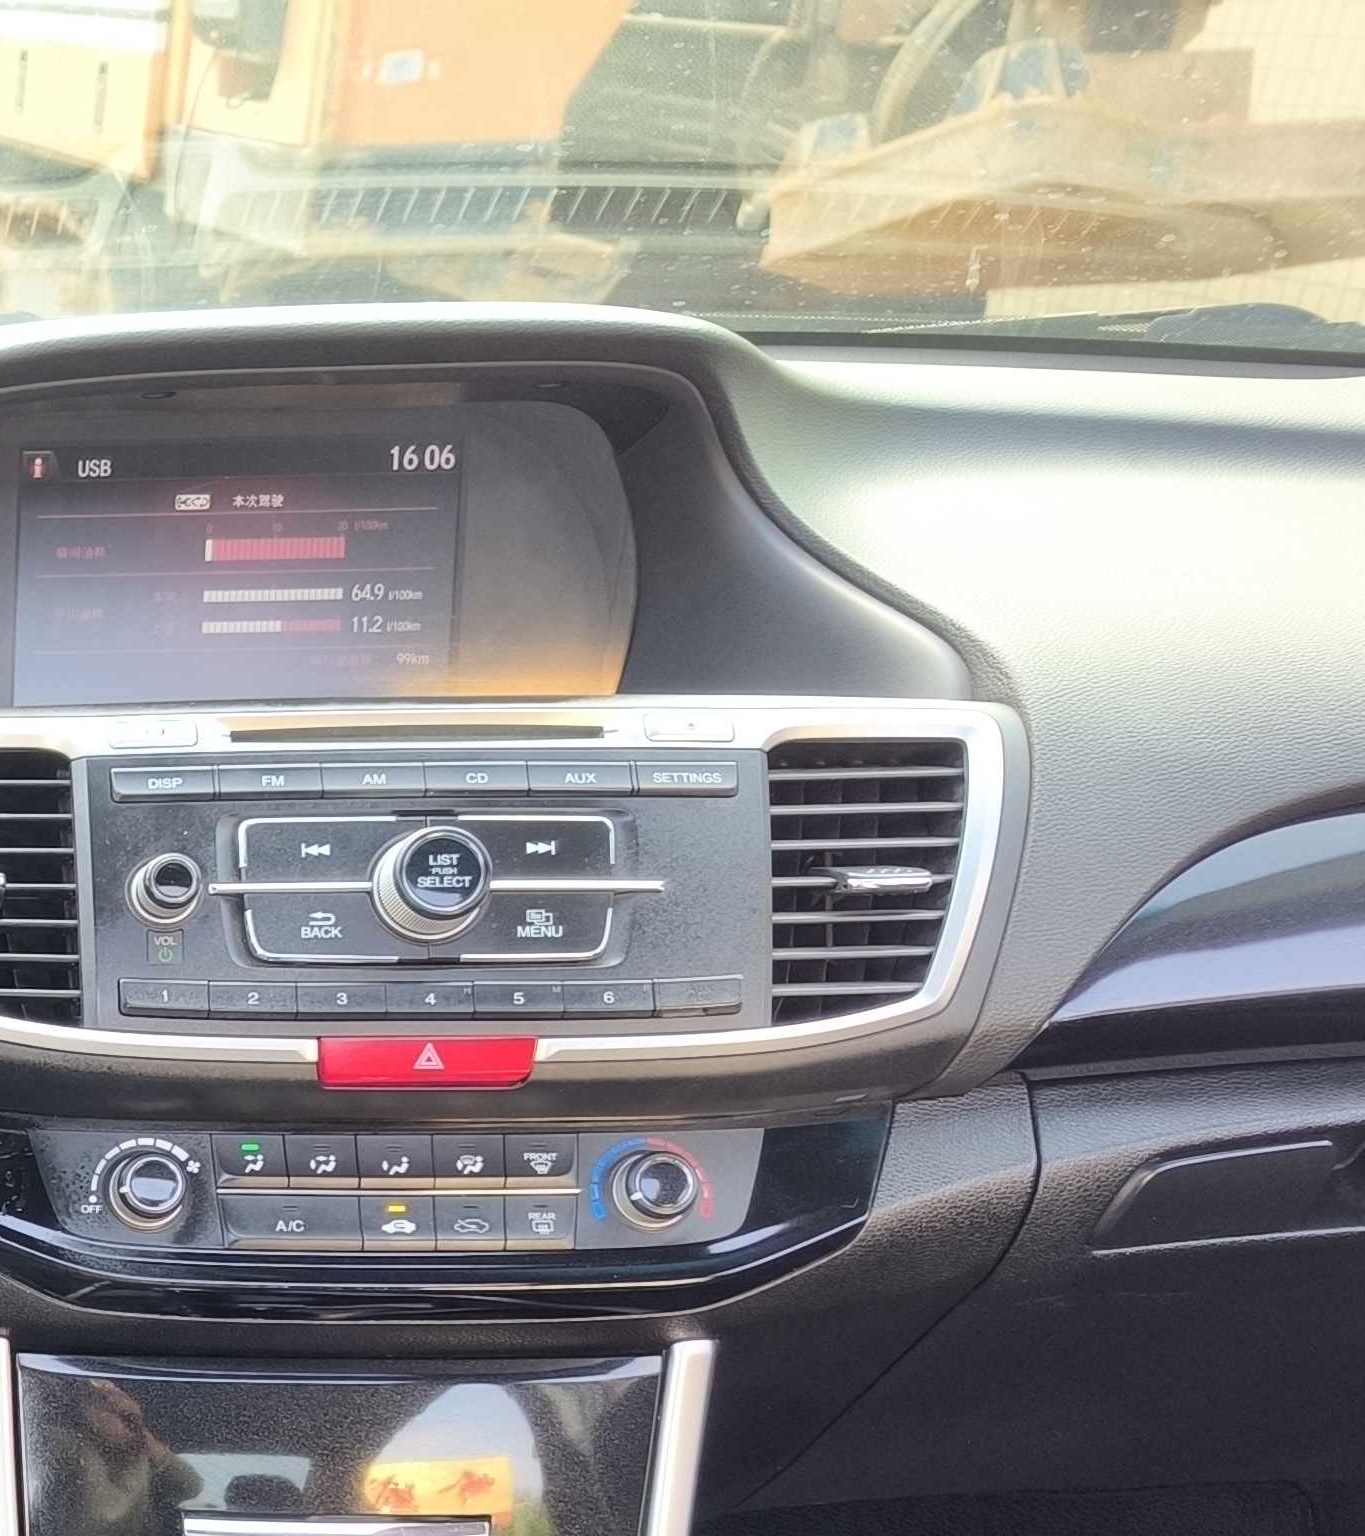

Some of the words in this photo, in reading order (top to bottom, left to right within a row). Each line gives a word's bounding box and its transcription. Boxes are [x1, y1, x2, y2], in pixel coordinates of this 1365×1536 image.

[77, 459, 112, 477] USB
[351, 583, 385, 601] 64.9
[351, 615, 383, 633] 11.2
[148, 777, 183, 789] DISP
[261, 775, 285, 787] FM
[362, 773, 387, 785] AM
[465, 772, 489, 784] CD
[564, 772, 597, 784] AUX
[652, 772, 723, 784] SETTINGS
[428, 854, 460, 866] LIST
[417, 876, 473, 888] SELECT
[300, 926, 342, 939] BACK
[517, 925, 563, 938] MENU
[154, 936, 177, 946] VOL
[161, 989, 168, 1003] 1
[247, 991, 259, 1005] 2
[336, 992, 348, 1005] 3
[424, 992, 437, 1005] 4
[512, 992, 525, 1005] 5
[602, 991, 615, 1004] 6
[523, 1152, 558, 1161] FRONT
[80, 1205, 103, 1214] OFF
[527, 1212, 556, 1220] REAR
[275, 1220, 305, 1232] A/C
